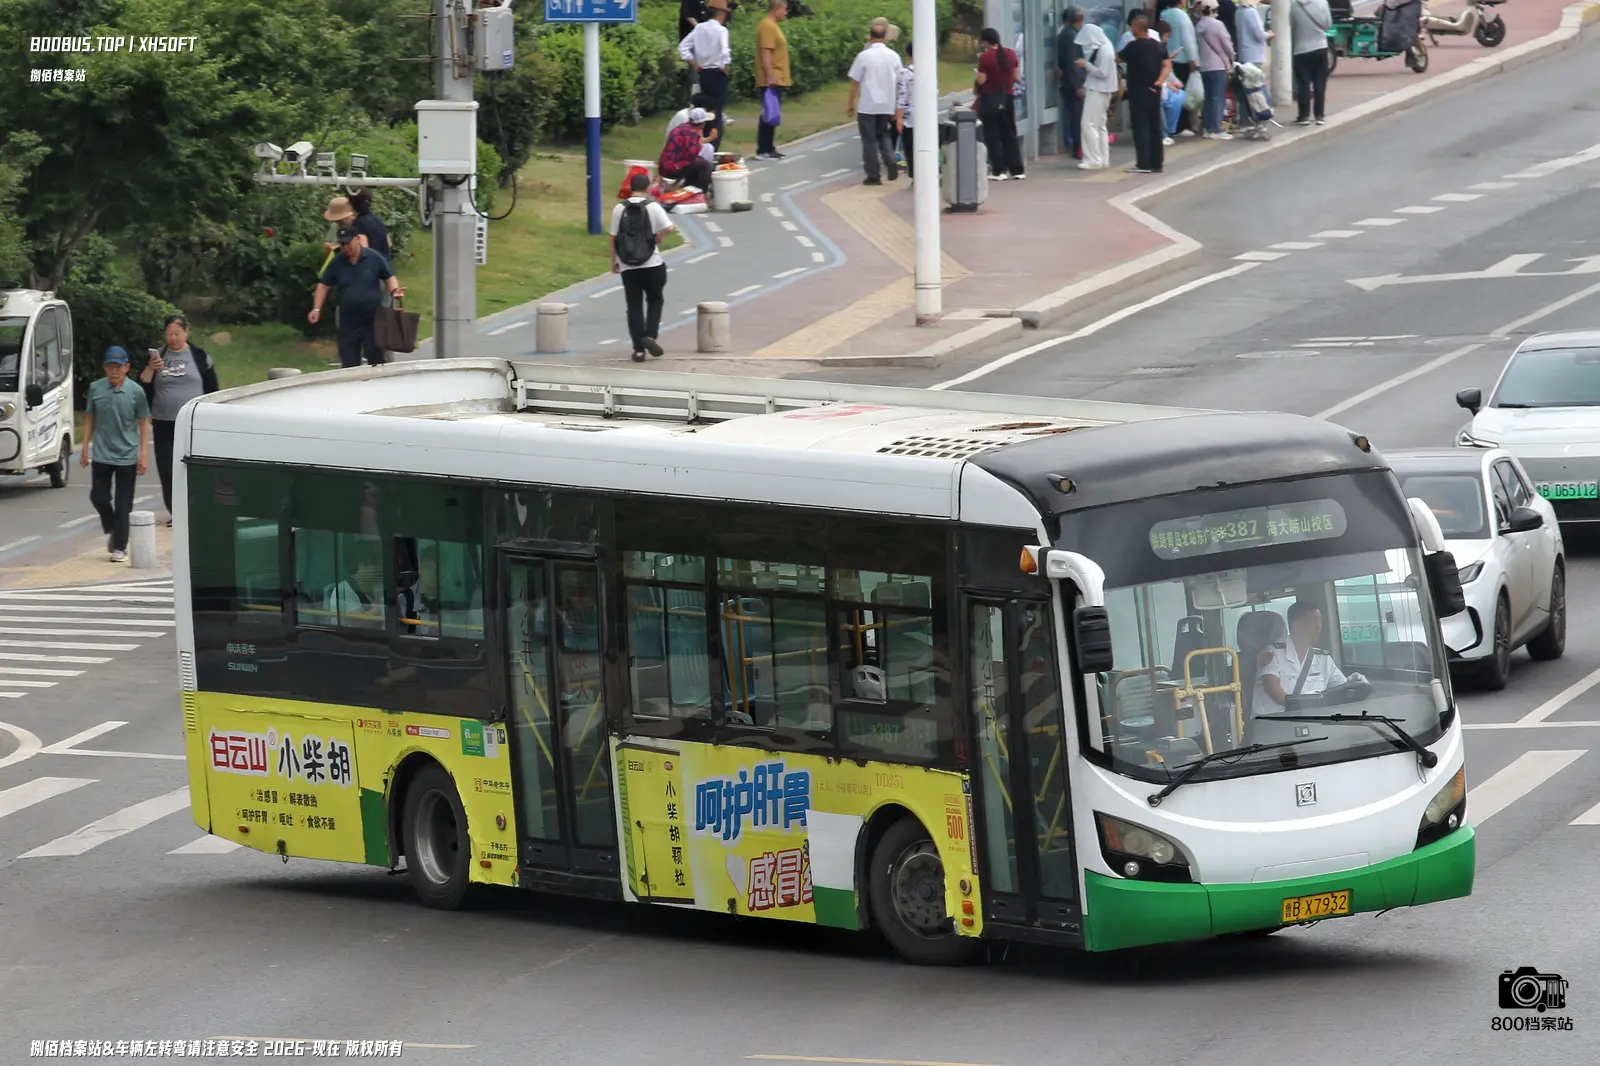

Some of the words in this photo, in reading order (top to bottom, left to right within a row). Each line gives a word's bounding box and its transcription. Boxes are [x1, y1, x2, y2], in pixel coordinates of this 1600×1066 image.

[1266, 514, 1334, 537] 海大崂山校区
[227, 662, 258, 673] SUNWIN
[210, 732, 268, 772] 白云山
[279, 737, 351, 785] 小柴胡
[256, 789, 278, 804] 治感冒
[289, 792, 318, 808] 解表散热
[696, 762, 810, 841] 呵护肝胃
[242, 808, 268, 824] 呵护肝胃
[279, 813, 294, 827] 呕吐
[306, 815, 336, 831] 食欲不振
[946, 814, 964, 840] 500
[665, 780, 686, 887] 小柴胡颗粒
